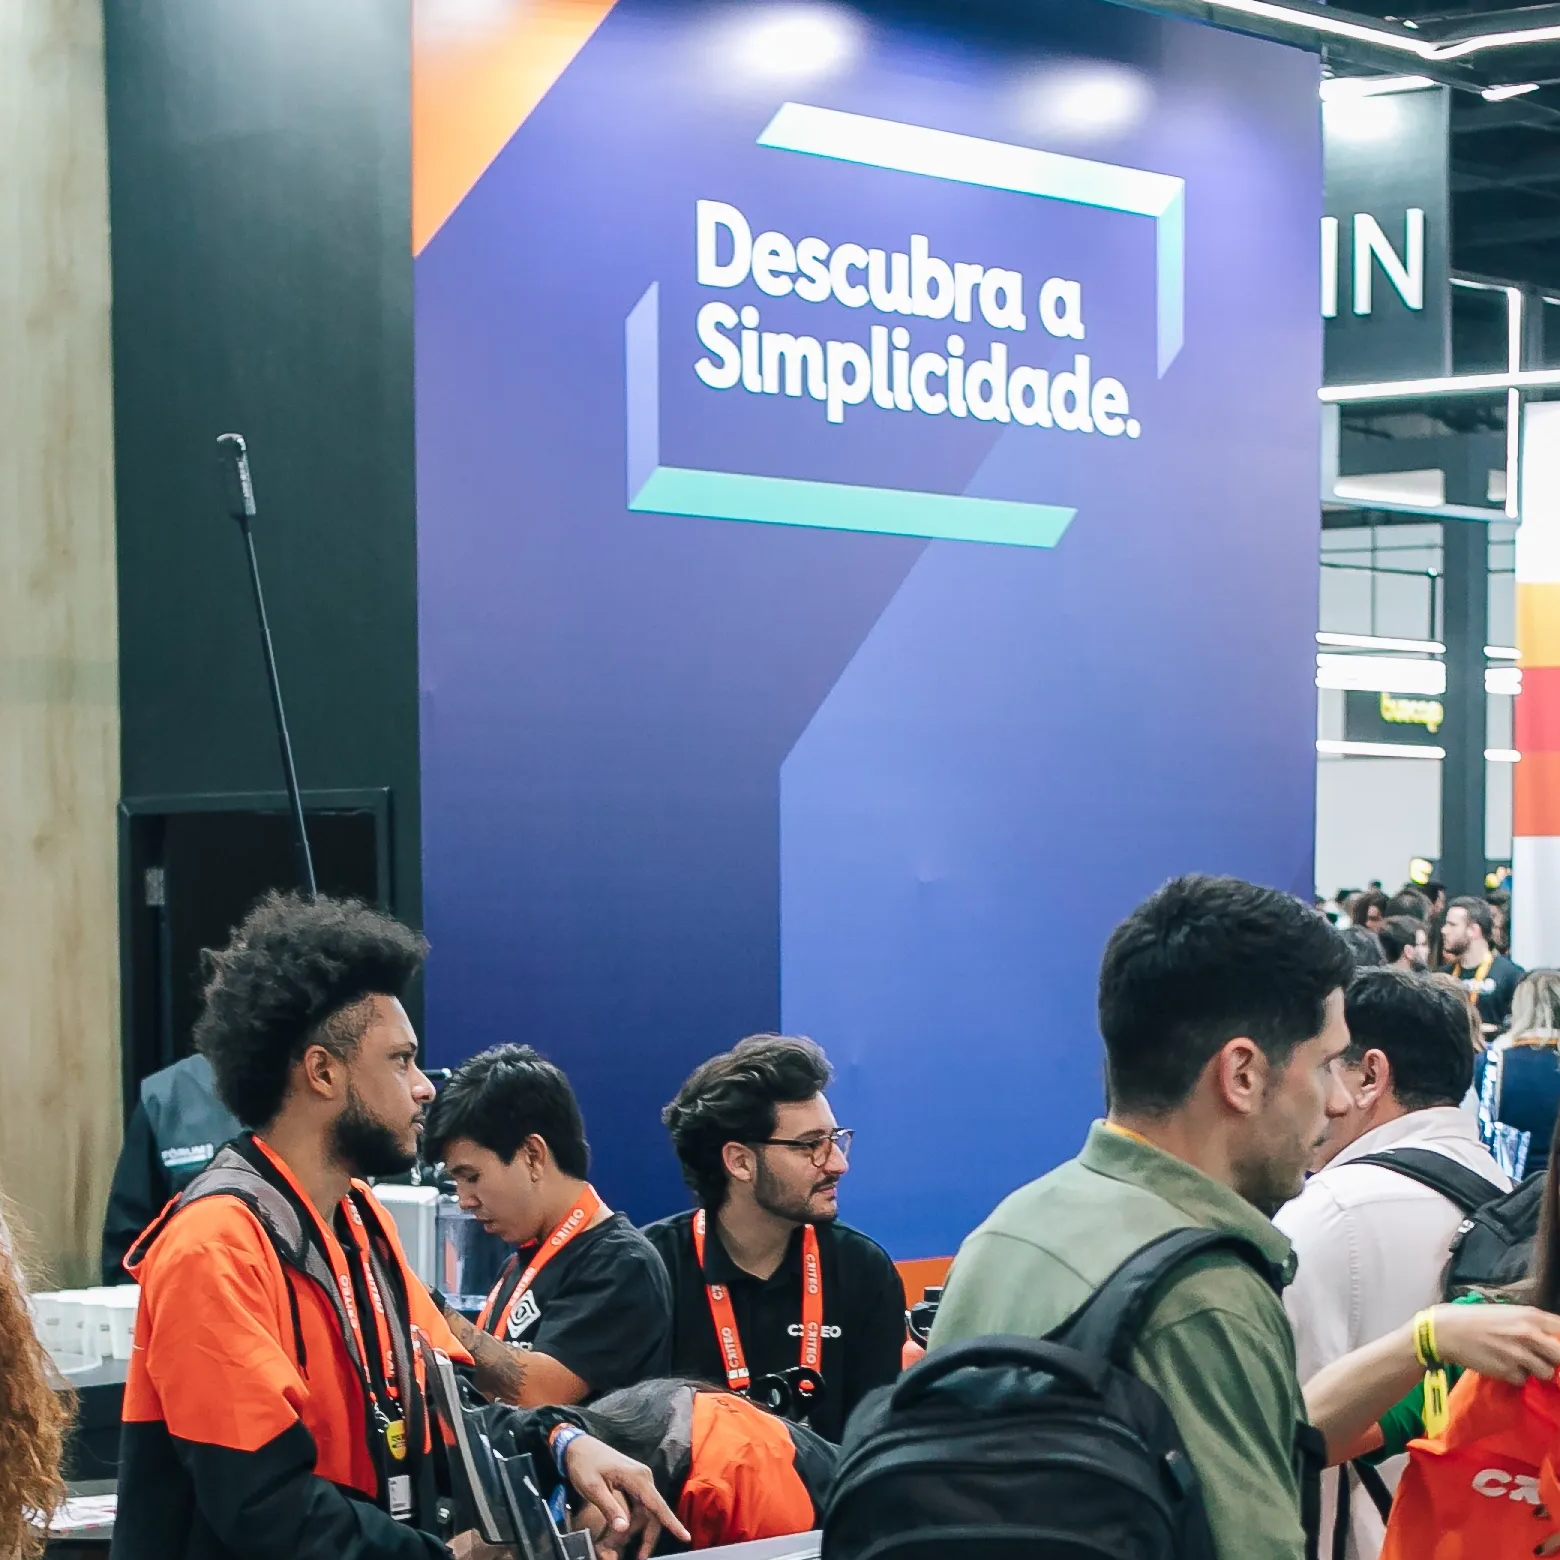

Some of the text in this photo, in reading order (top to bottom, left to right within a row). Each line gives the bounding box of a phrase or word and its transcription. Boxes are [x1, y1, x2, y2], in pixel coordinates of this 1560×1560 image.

[695, 199, 1085, 340] Descubra a
[693, 302, 1142, 439] Simplicidade.
[551, 1208, 585, 1247] CRITEO
[805, 1253, 819, 1294] CRITEO
[806, 1321, 820, 1365] CRITEO
